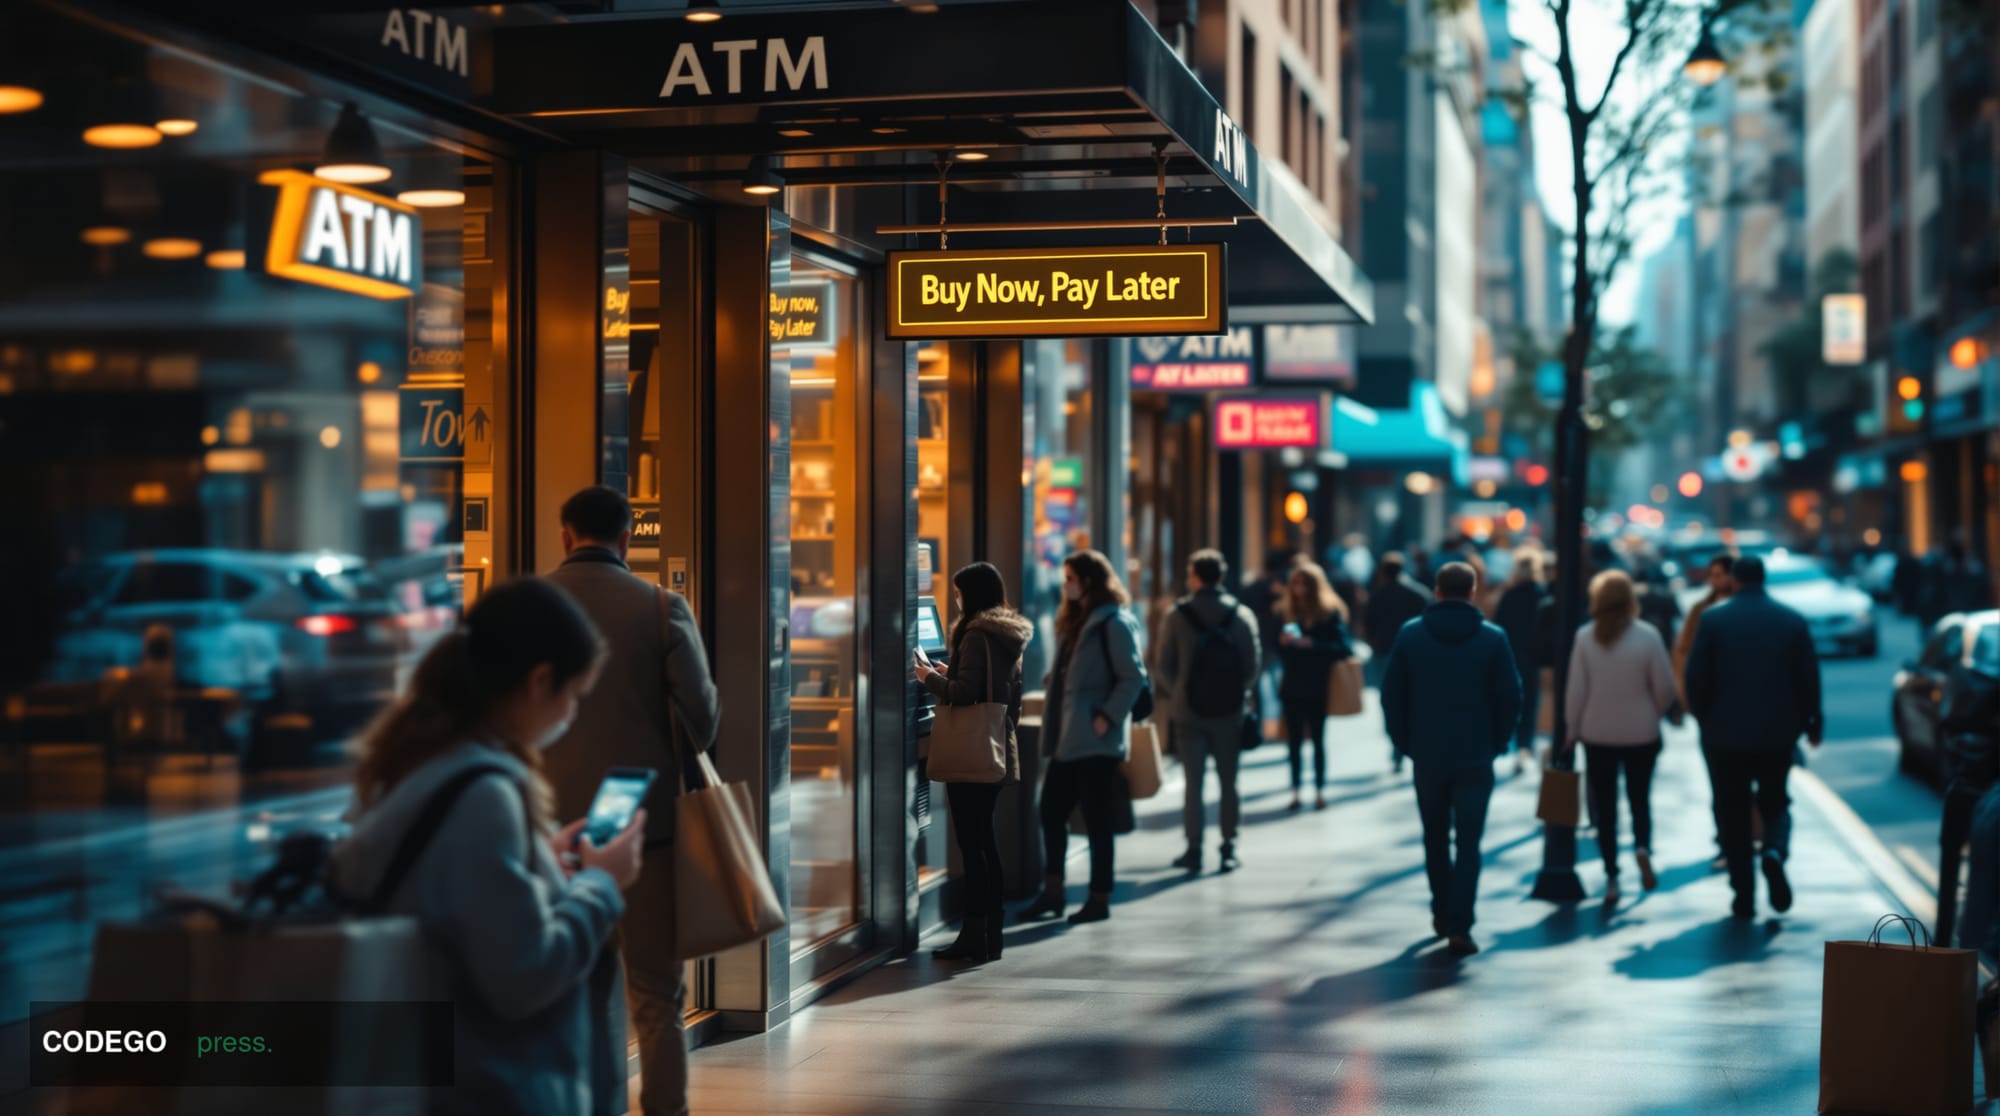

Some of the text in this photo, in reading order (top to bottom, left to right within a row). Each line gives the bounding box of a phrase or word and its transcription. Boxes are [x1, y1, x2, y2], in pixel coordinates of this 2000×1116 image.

[381, 8, 468, 77] ATM
[659, 36, 829, 98] ATM
[1214, 108, 1248, 188] ATM
[303, 187, 412, 283] ATM
[605, 287, 630, 315] Buy
[921, 270, 1180, 312] Buy Now, Pay Later
[786, 317, 817, 337] Later
